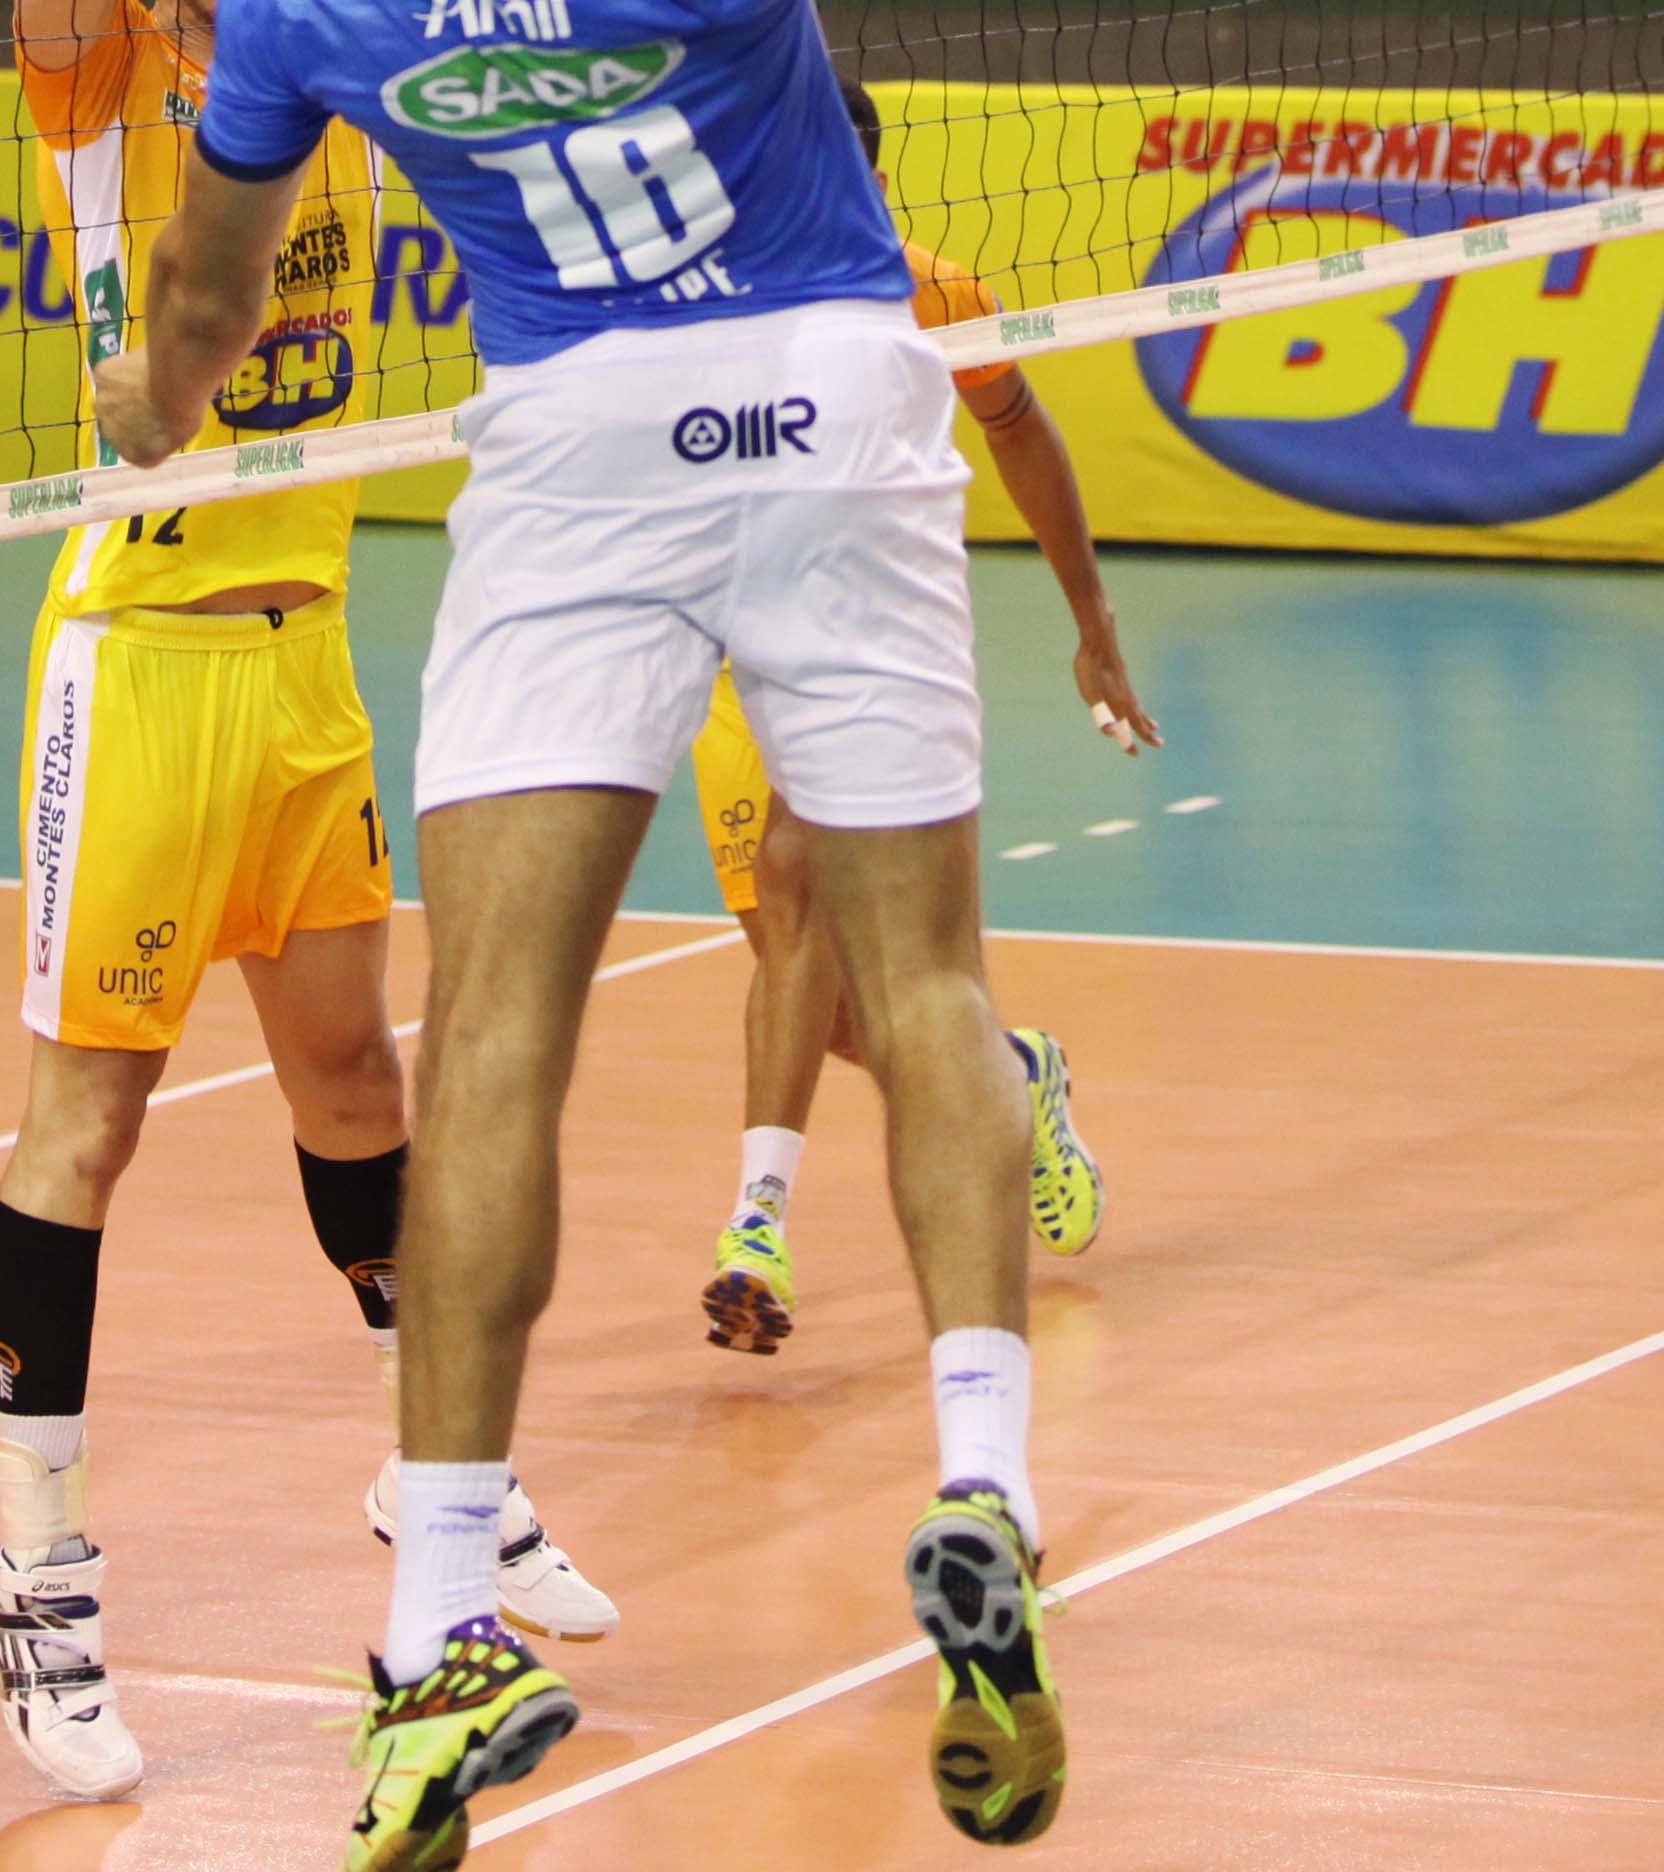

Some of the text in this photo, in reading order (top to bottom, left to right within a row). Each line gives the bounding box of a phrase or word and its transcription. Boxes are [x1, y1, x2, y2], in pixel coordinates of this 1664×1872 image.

[419, 49, 648, 123] SADA
[9, 477, 82, 519] SUPERLIGA
[235, 440, 304, 480] SUPERLIGA
[36, 733, 61, 868] CIMENTO
[43, 679, 75, 929] MONTES CLAROS
[98, 965, 164, 996] unic
